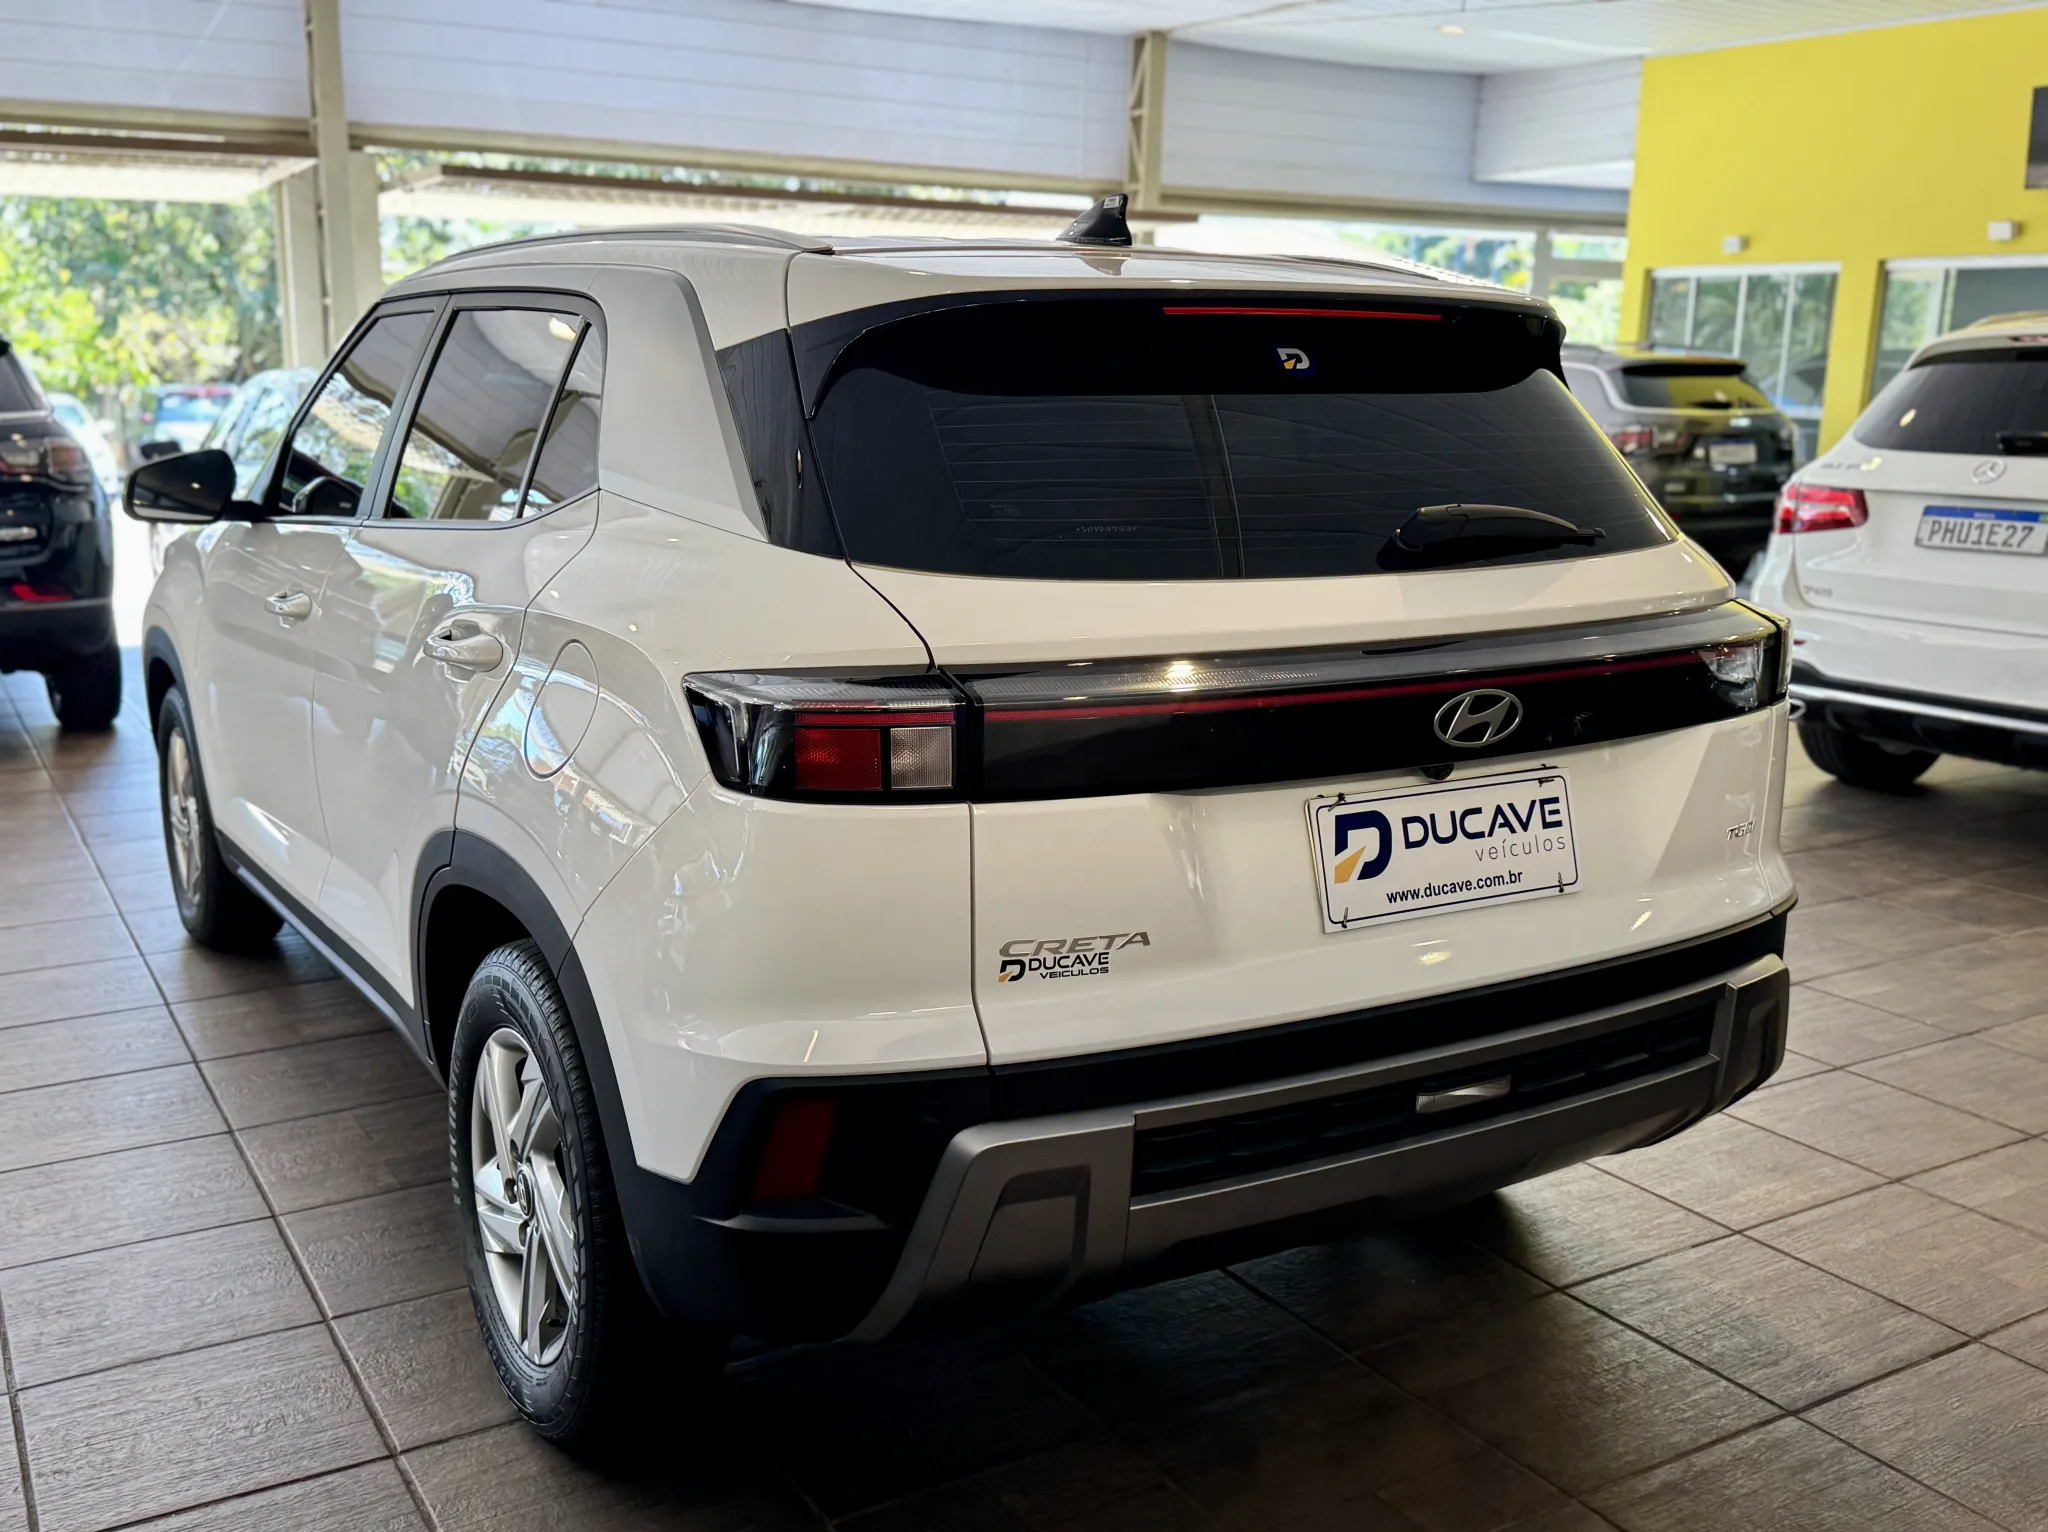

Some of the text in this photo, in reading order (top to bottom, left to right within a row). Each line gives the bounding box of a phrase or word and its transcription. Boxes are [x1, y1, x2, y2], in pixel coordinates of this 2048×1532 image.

[1928, 519, 2035, 548] PHU1E27
[1401, 796, 1563, 850] DUCAVE
[1475, 835, 1566, 862] veículos
[1386, 869, 1523, 904] www.ducave.com.br
[999, 931, 1151, 958] CRETA
[1028, 951, 1110, 972] DUCAVE
[1039, 966, 1110, 980] VEICULOS
